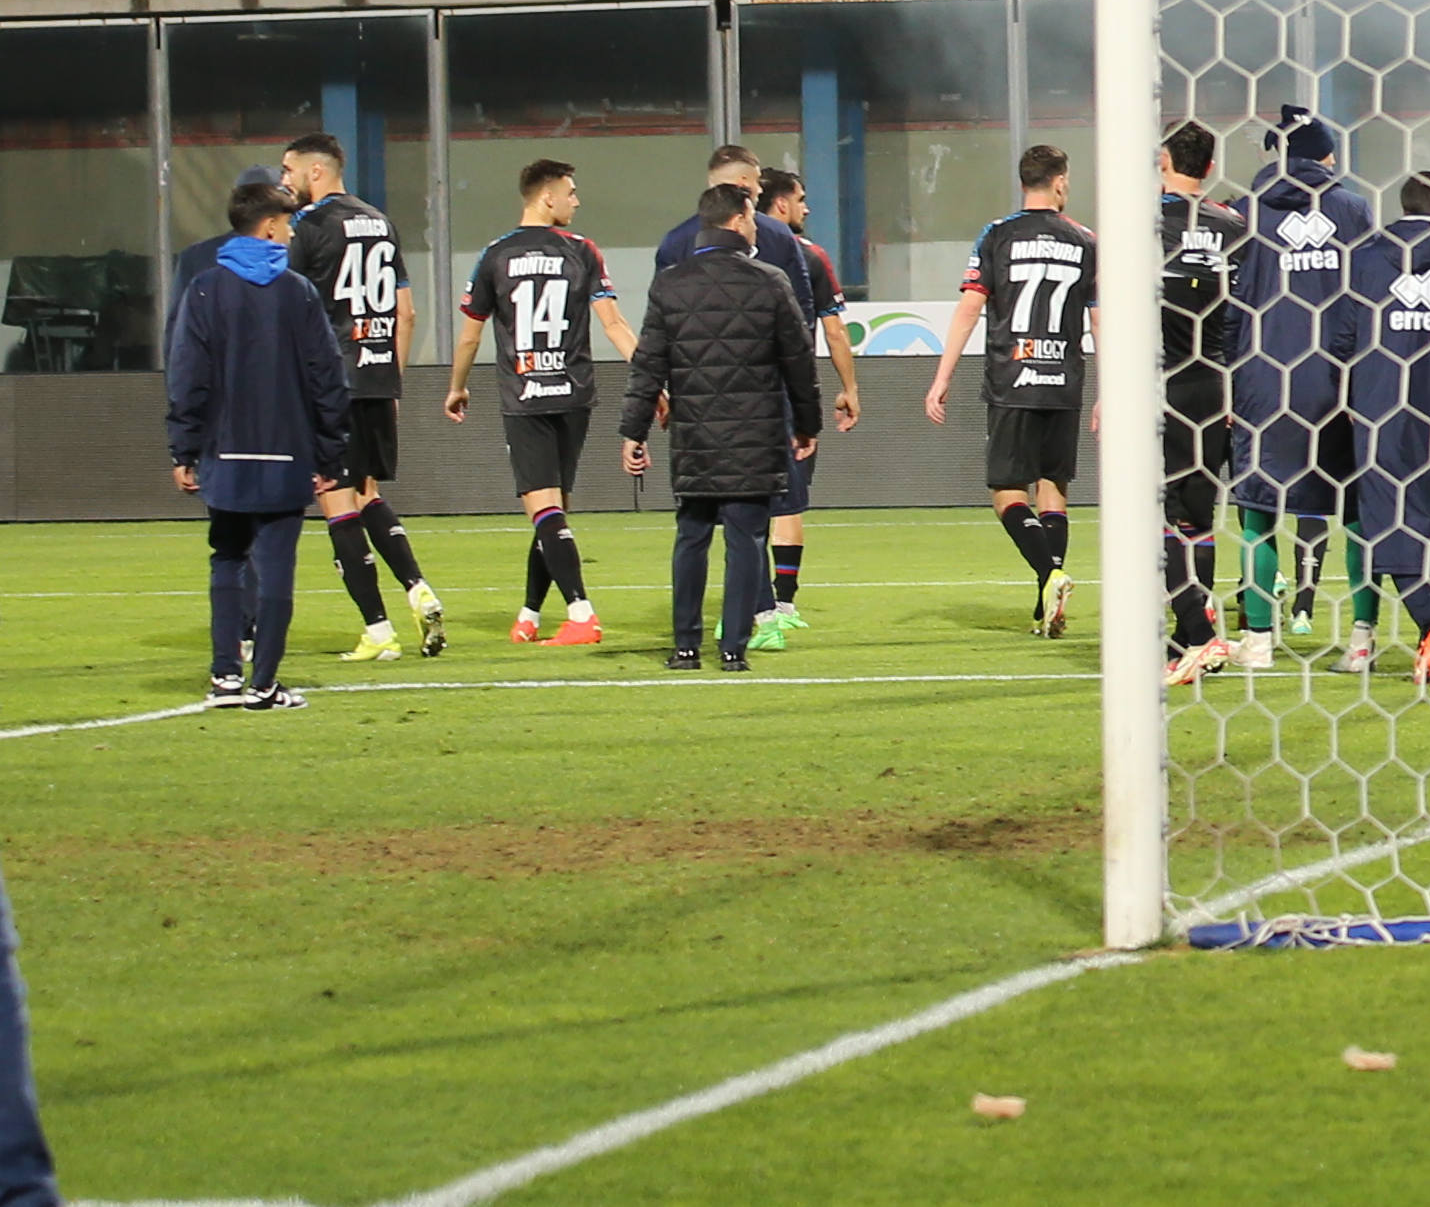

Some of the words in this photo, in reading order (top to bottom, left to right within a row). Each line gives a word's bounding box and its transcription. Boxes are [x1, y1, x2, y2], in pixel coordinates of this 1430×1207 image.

[508, 257, 565, 277] KONTEK
[1010, 240, 1084, 263] MARSURA
[333, 241, 397, 316] 46
[1009, 263, 1082, 333] 77
[510, 279, 570, 351] 14
[1014, 338, 1067, 360] TRILOGY
